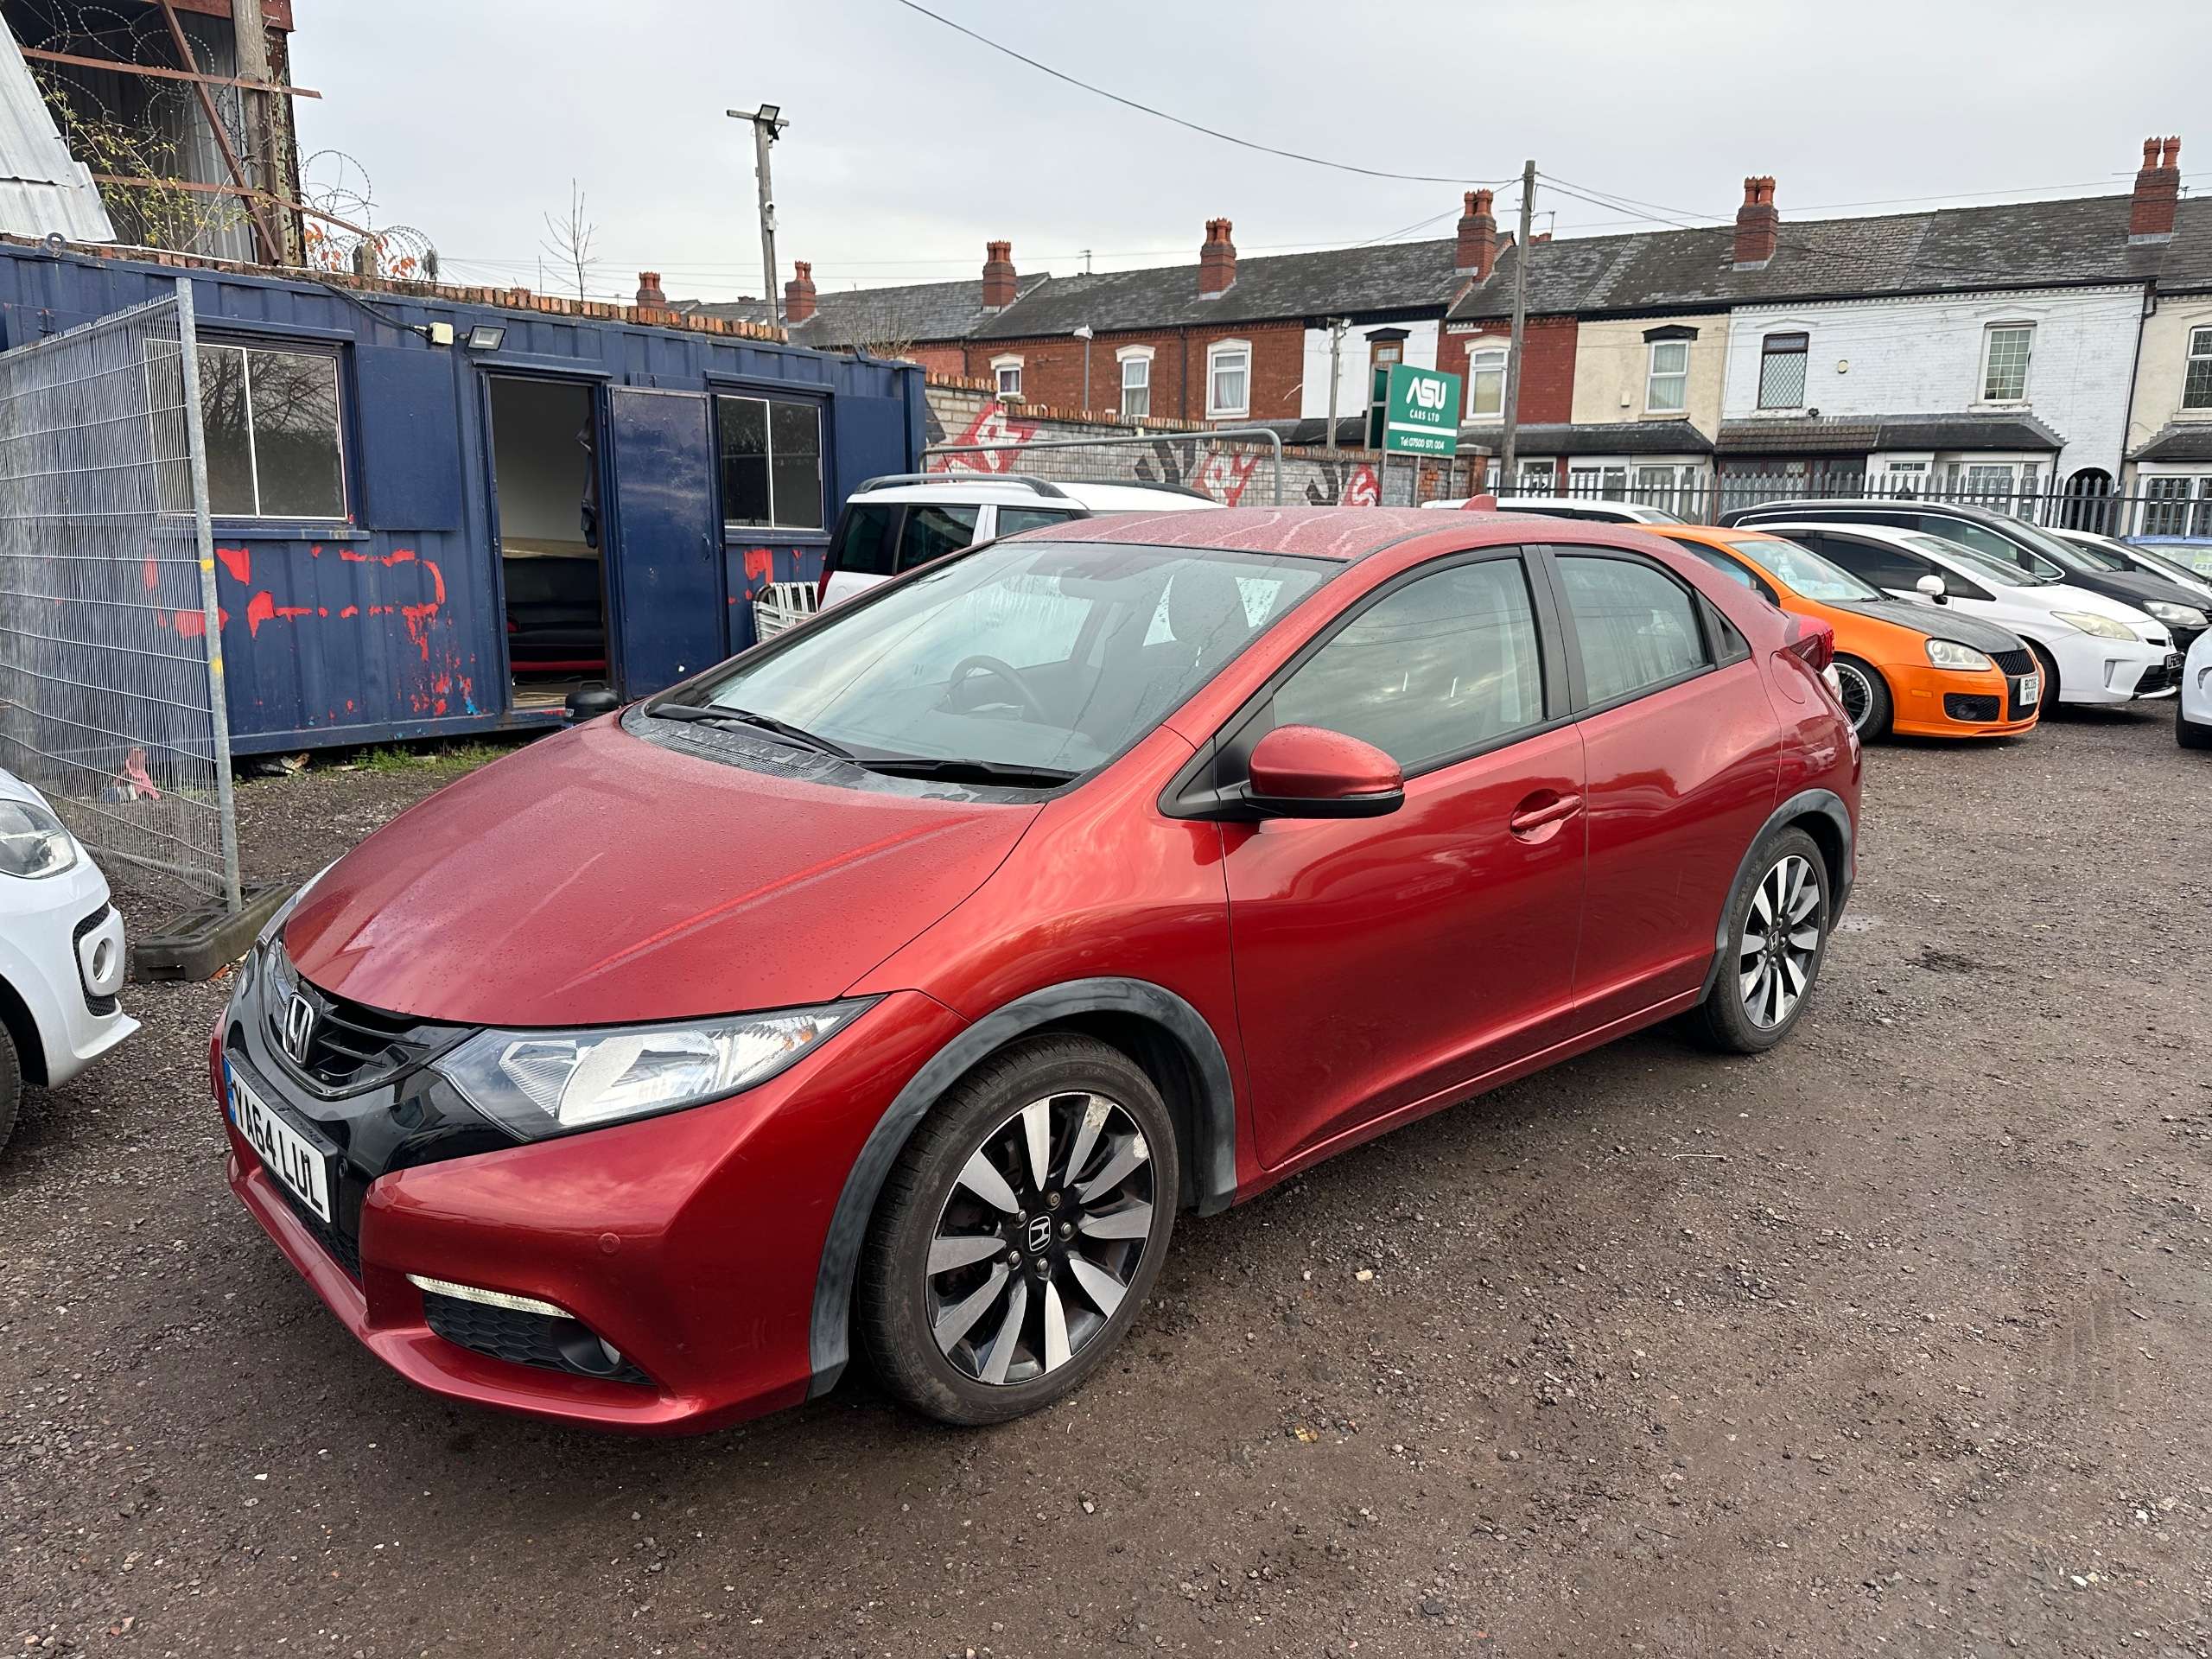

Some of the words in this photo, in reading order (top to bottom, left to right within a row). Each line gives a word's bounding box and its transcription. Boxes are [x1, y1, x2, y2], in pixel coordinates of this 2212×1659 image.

[1406, 377, 1446, 410] ASU
[1410, 410, 1426, 421] CARS
[1427, 412, 1440, 422] LTD
[232, 1079, 276, 1167] YA64
[277, 1129, 324, 1214] LUL
